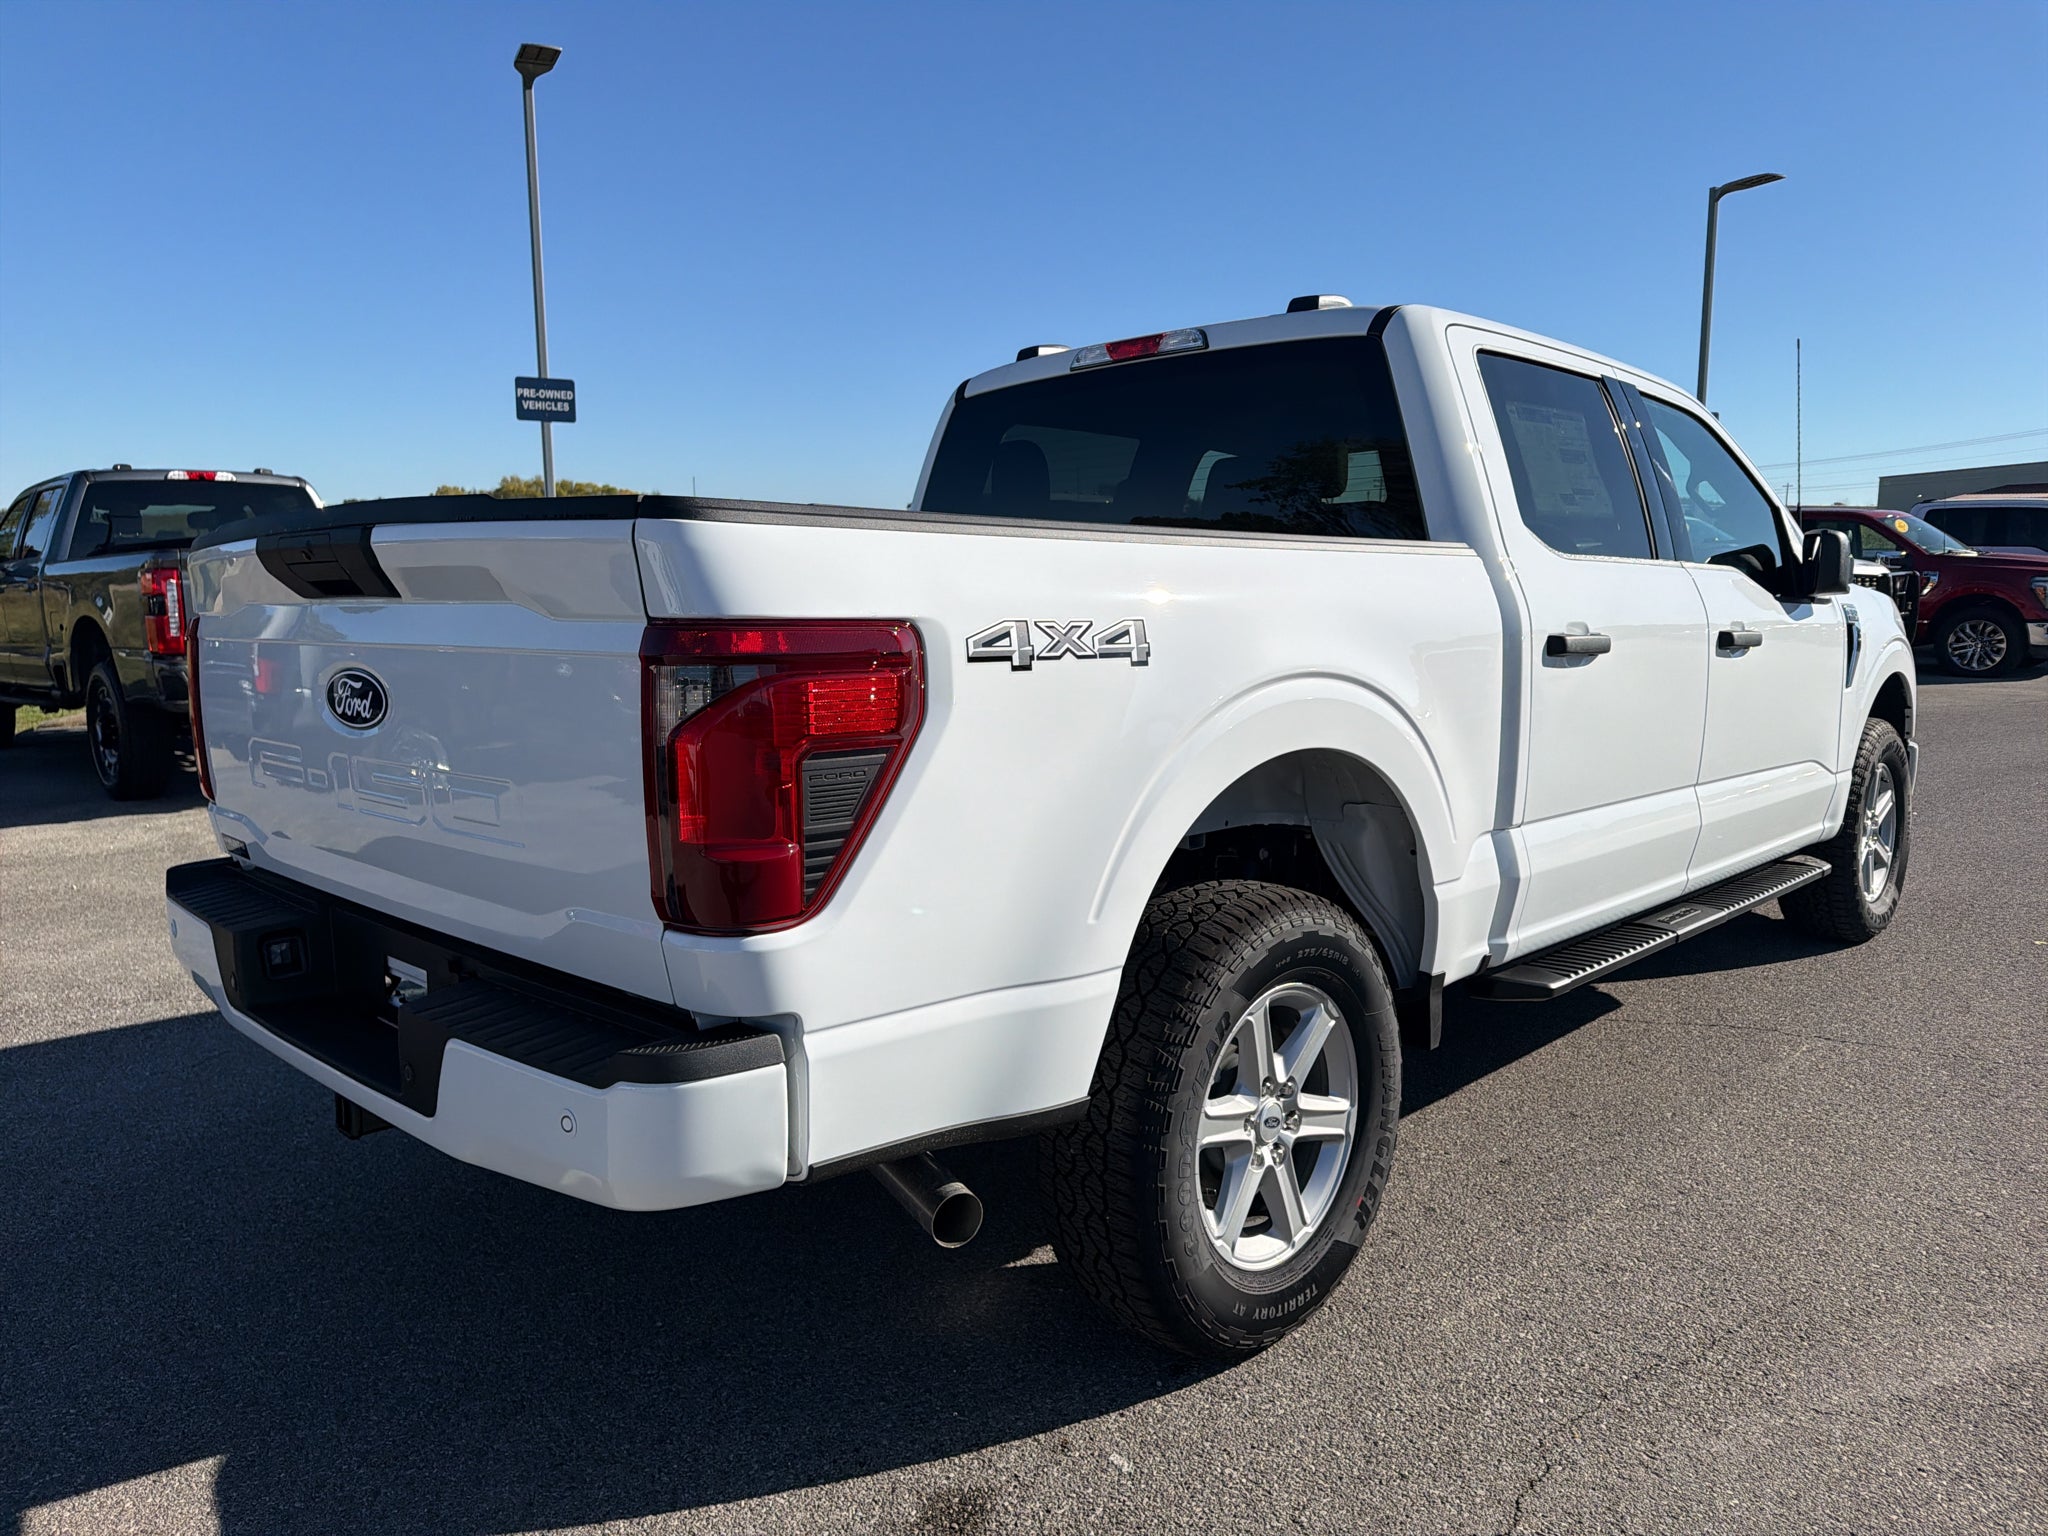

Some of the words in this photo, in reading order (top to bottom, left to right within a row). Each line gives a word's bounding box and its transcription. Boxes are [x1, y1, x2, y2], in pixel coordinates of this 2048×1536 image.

[517, 388, 574, 400] PRE-OWNED
[522, 400, 570, 412] VEHICLES
[334, 677, 373, 719] Ford
[808, 770, 866, 782] FORD
[1178, 1011, 1231, 1257] GOODYEAR
[1354, 1020, 1398, 1231] WRANGLER
[1232, 1301, 1247, 1317] AT
[1252, 1283, 1318, 1320] TERRITORY
